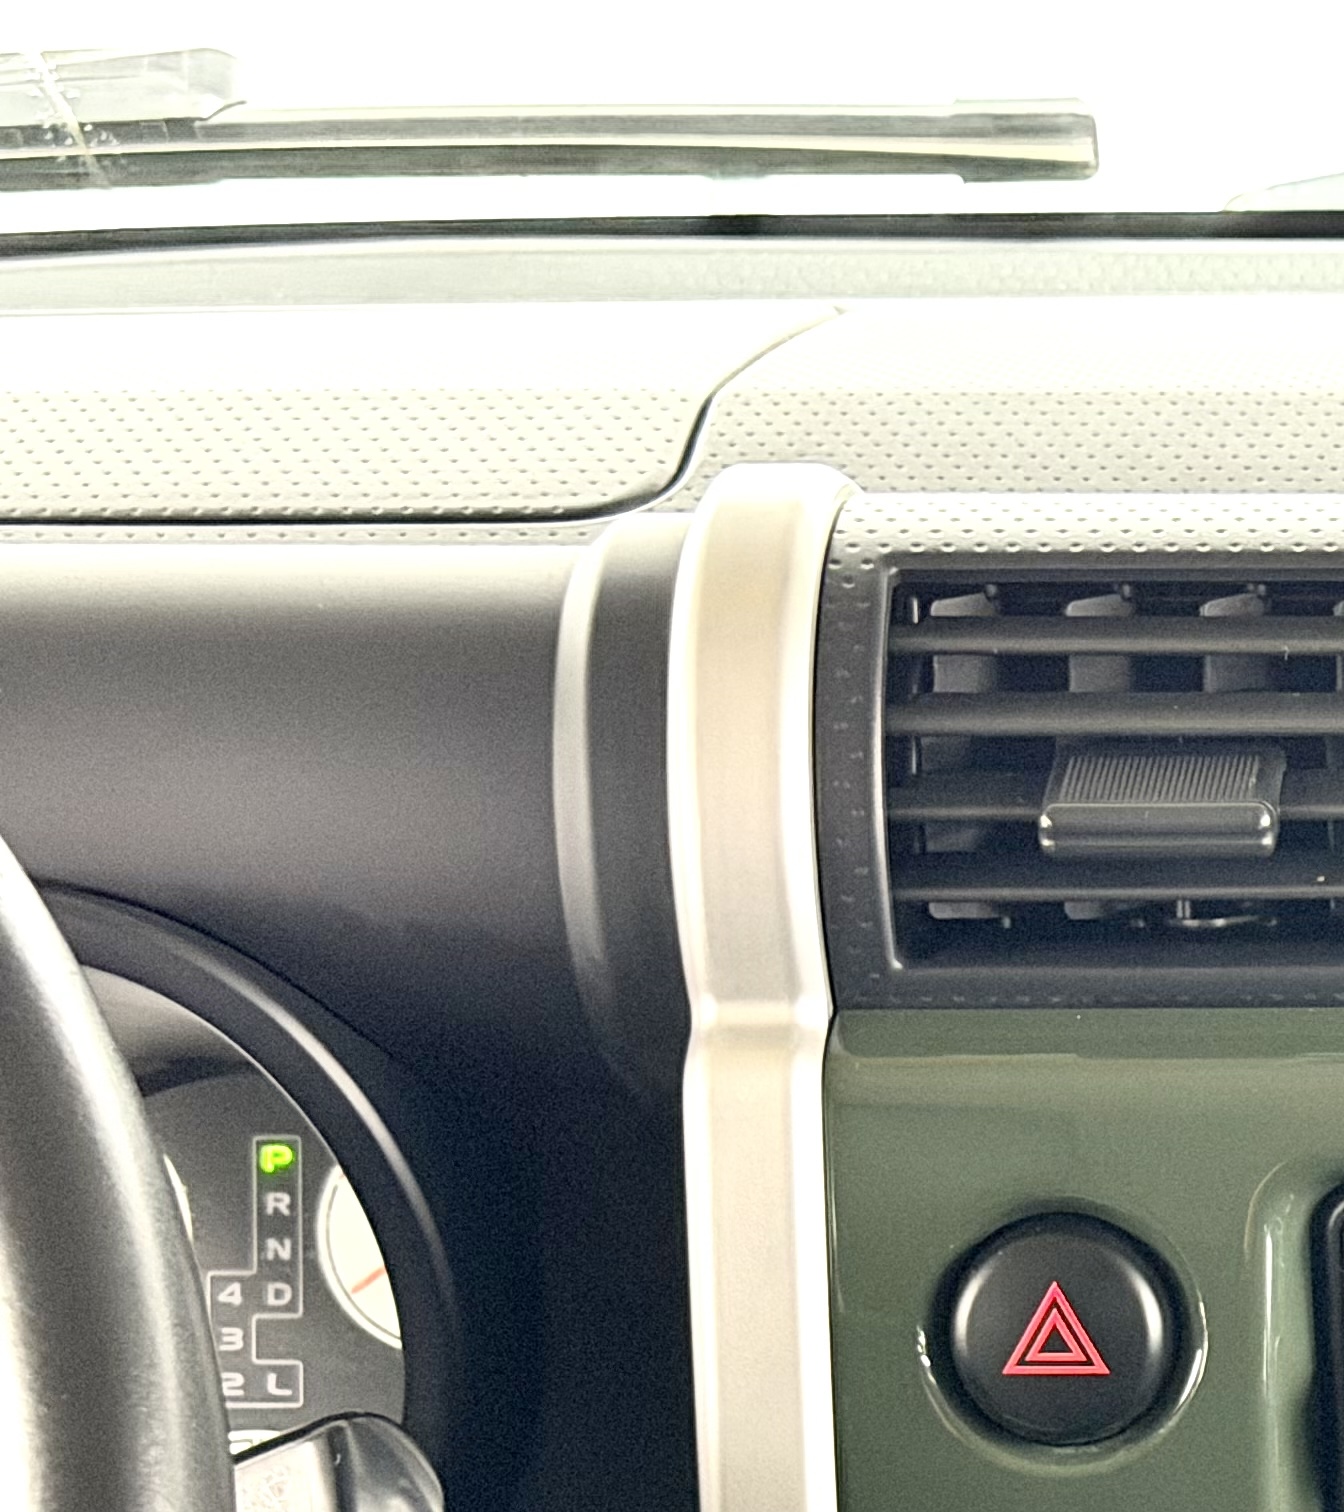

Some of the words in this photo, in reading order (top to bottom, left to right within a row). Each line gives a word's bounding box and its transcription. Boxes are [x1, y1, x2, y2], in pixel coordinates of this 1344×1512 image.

[260, 1143, 293, 1173] P
[266, 1192, 291, 1216] R
[266, 1238, 291, 1261] N
[217, 1282, 242, 1306] 4
[267, 1282, 292, 1306] D
[219, 1327, 244, 1351] 3
[221, 1372, 245, 1396] 2
[267, 1373, 292, 1396] L
